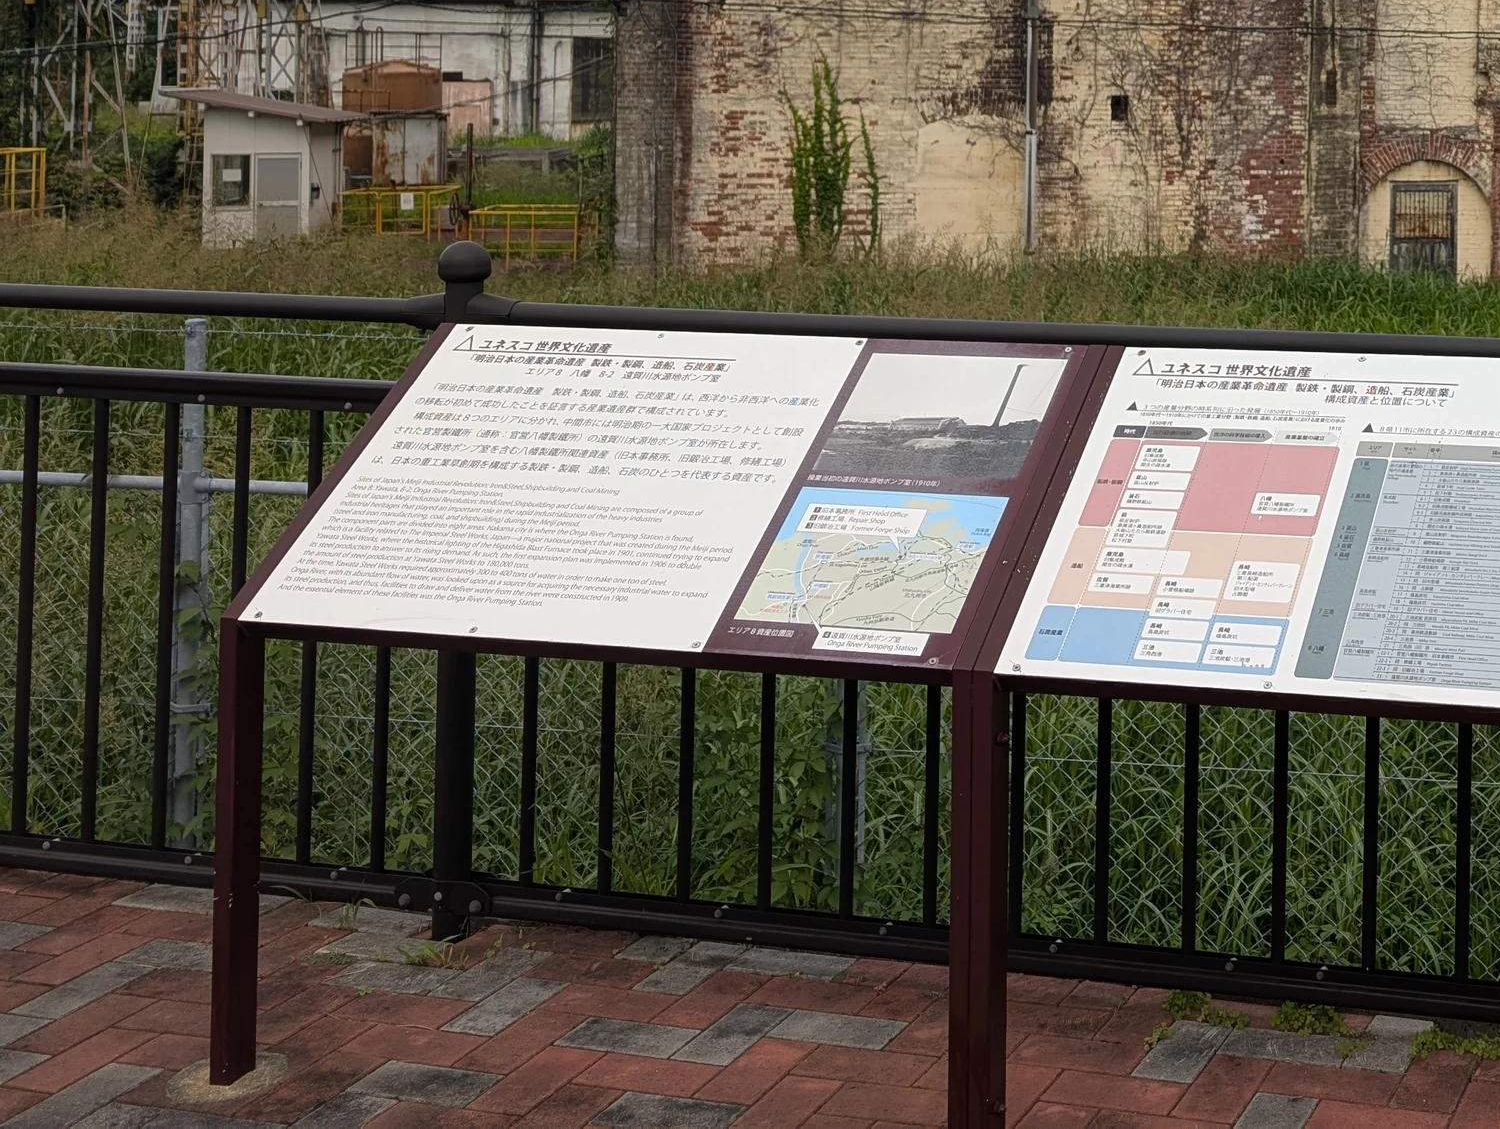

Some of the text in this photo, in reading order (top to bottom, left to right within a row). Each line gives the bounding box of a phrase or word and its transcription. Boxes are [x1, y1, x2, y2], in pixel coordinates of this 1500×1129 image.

[478, 339, 613, 354] ユネスコ 世界文化遺産
[469, 353, 731, 372] 「明治日本の産業革命遺産 製鉄・製鋼、造船、石炭産業」
[1160, 362, 1312, 378] ユネスコ 世界文化遺産
[568, 369, 592, 378] 八幡
[598, 370, 615, 378] 8-2
[620, 370, 722, 383] 遠賀川水源地ポンプ室
[433, 382, 544, 395] 「明治日本の産業革命遺産
[1155, 378, 1455, 398] 「明治日本の産業革命遺産 製鉄・製鋼、造船、石炭産業」
[414, 396, 728, 418] の移転が初めて成功したことを証言する産業遺産群で構成されています。
[1323, 394, 1448, 408] 構成資産と位置について
[350, 483, 367, 491] Area
[374, 484, 398, 493] Yawata,
[399, 485, 413, 493] 8-2:
[412, 486, 432, 495] Onga
[431, 487, 450, 495] River
[448, 488, 480, 498] Pumping
[478, 489, 503, 497] Station.
[356, 475, 374, 483] Sites
[379, 476, 405, 485] Japan's
[404, 477, 423, 486] Meiji
[421, 478, 454, 486] Industrial
[451, 480, 490, 488] Revolution:
[488, 482, 566, 494] Iron&Steel,Shipbuilding
[580, 486, 597, 494] Coal
[595, 487, 620, 496] Mining
[848, 516, 869, 524] Repair
[868, 517, 886, 525] Shop
[850, 524, 874, 532] Former
[874, 526, 893, 534] Forge
[893, 527, 910, 535] Shop
[276, 583, 294, 591] And
[292, 584, 305, 592] the
[304, 585, 336, 593] essential
[333, 586, 364, 595] element
[362, 588, 374, 596] of
[370, 588, 391, 597] these
[390, 589, 419, 599] facilities
[433, 592, 447, 601] the
[446, 593, 466, 603] Onga
[465, 594, 485, 603] River
[484, 596, 517, 607] Pumping
[516, 598, 543, 607] Station.
[830, 631, 902, 643] 遠賀川水源地ポンプ室
[826, 639, 918, 652] Onga River Pumping Station
